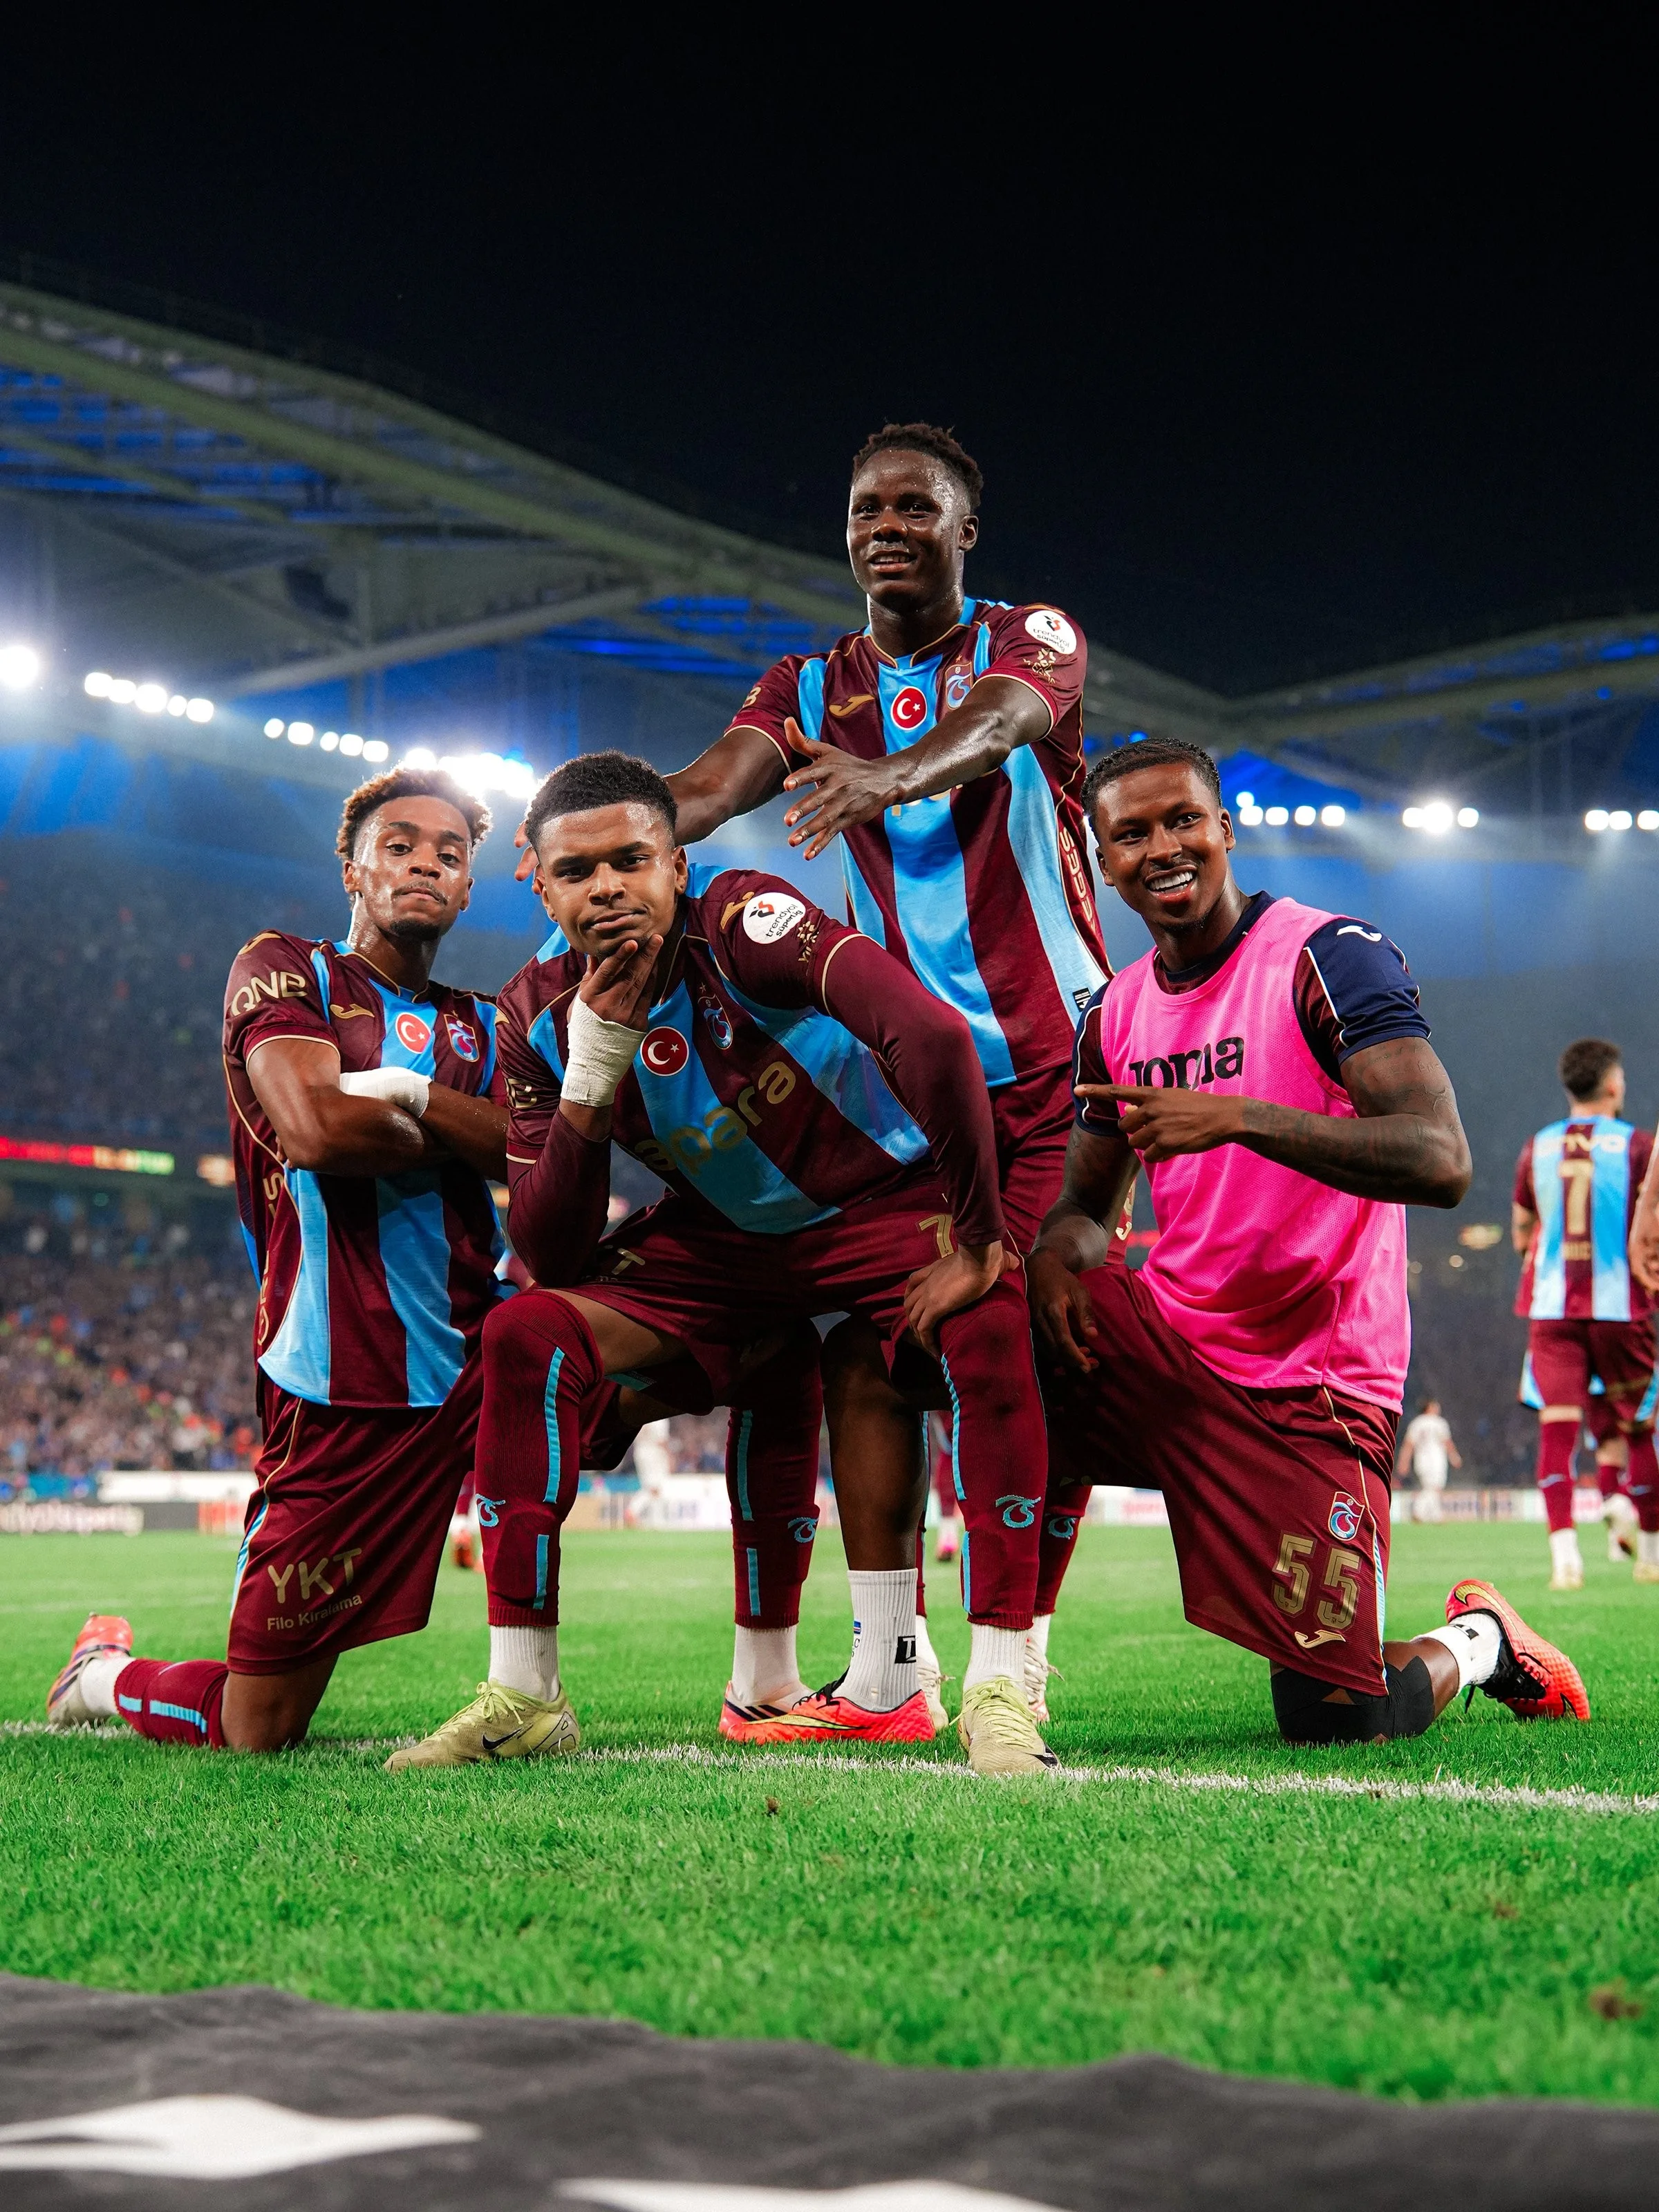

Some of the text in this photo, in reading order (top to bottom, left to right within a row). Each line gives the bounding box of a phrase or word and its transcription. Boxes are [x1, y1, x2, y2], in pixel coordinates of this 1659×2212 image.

[1033, 628, 1070, 648] trendyol
[765, 903, 798, 938] trendyol
[231, 971, 308, 1017] QNB
[635, 1061, 796, 1174] apara
[268, 1547, 362, 1604] YKT
[1271, 1532, 1361, 1631] 55
[267, 1594, 363, 1631] Filo Kiralama
